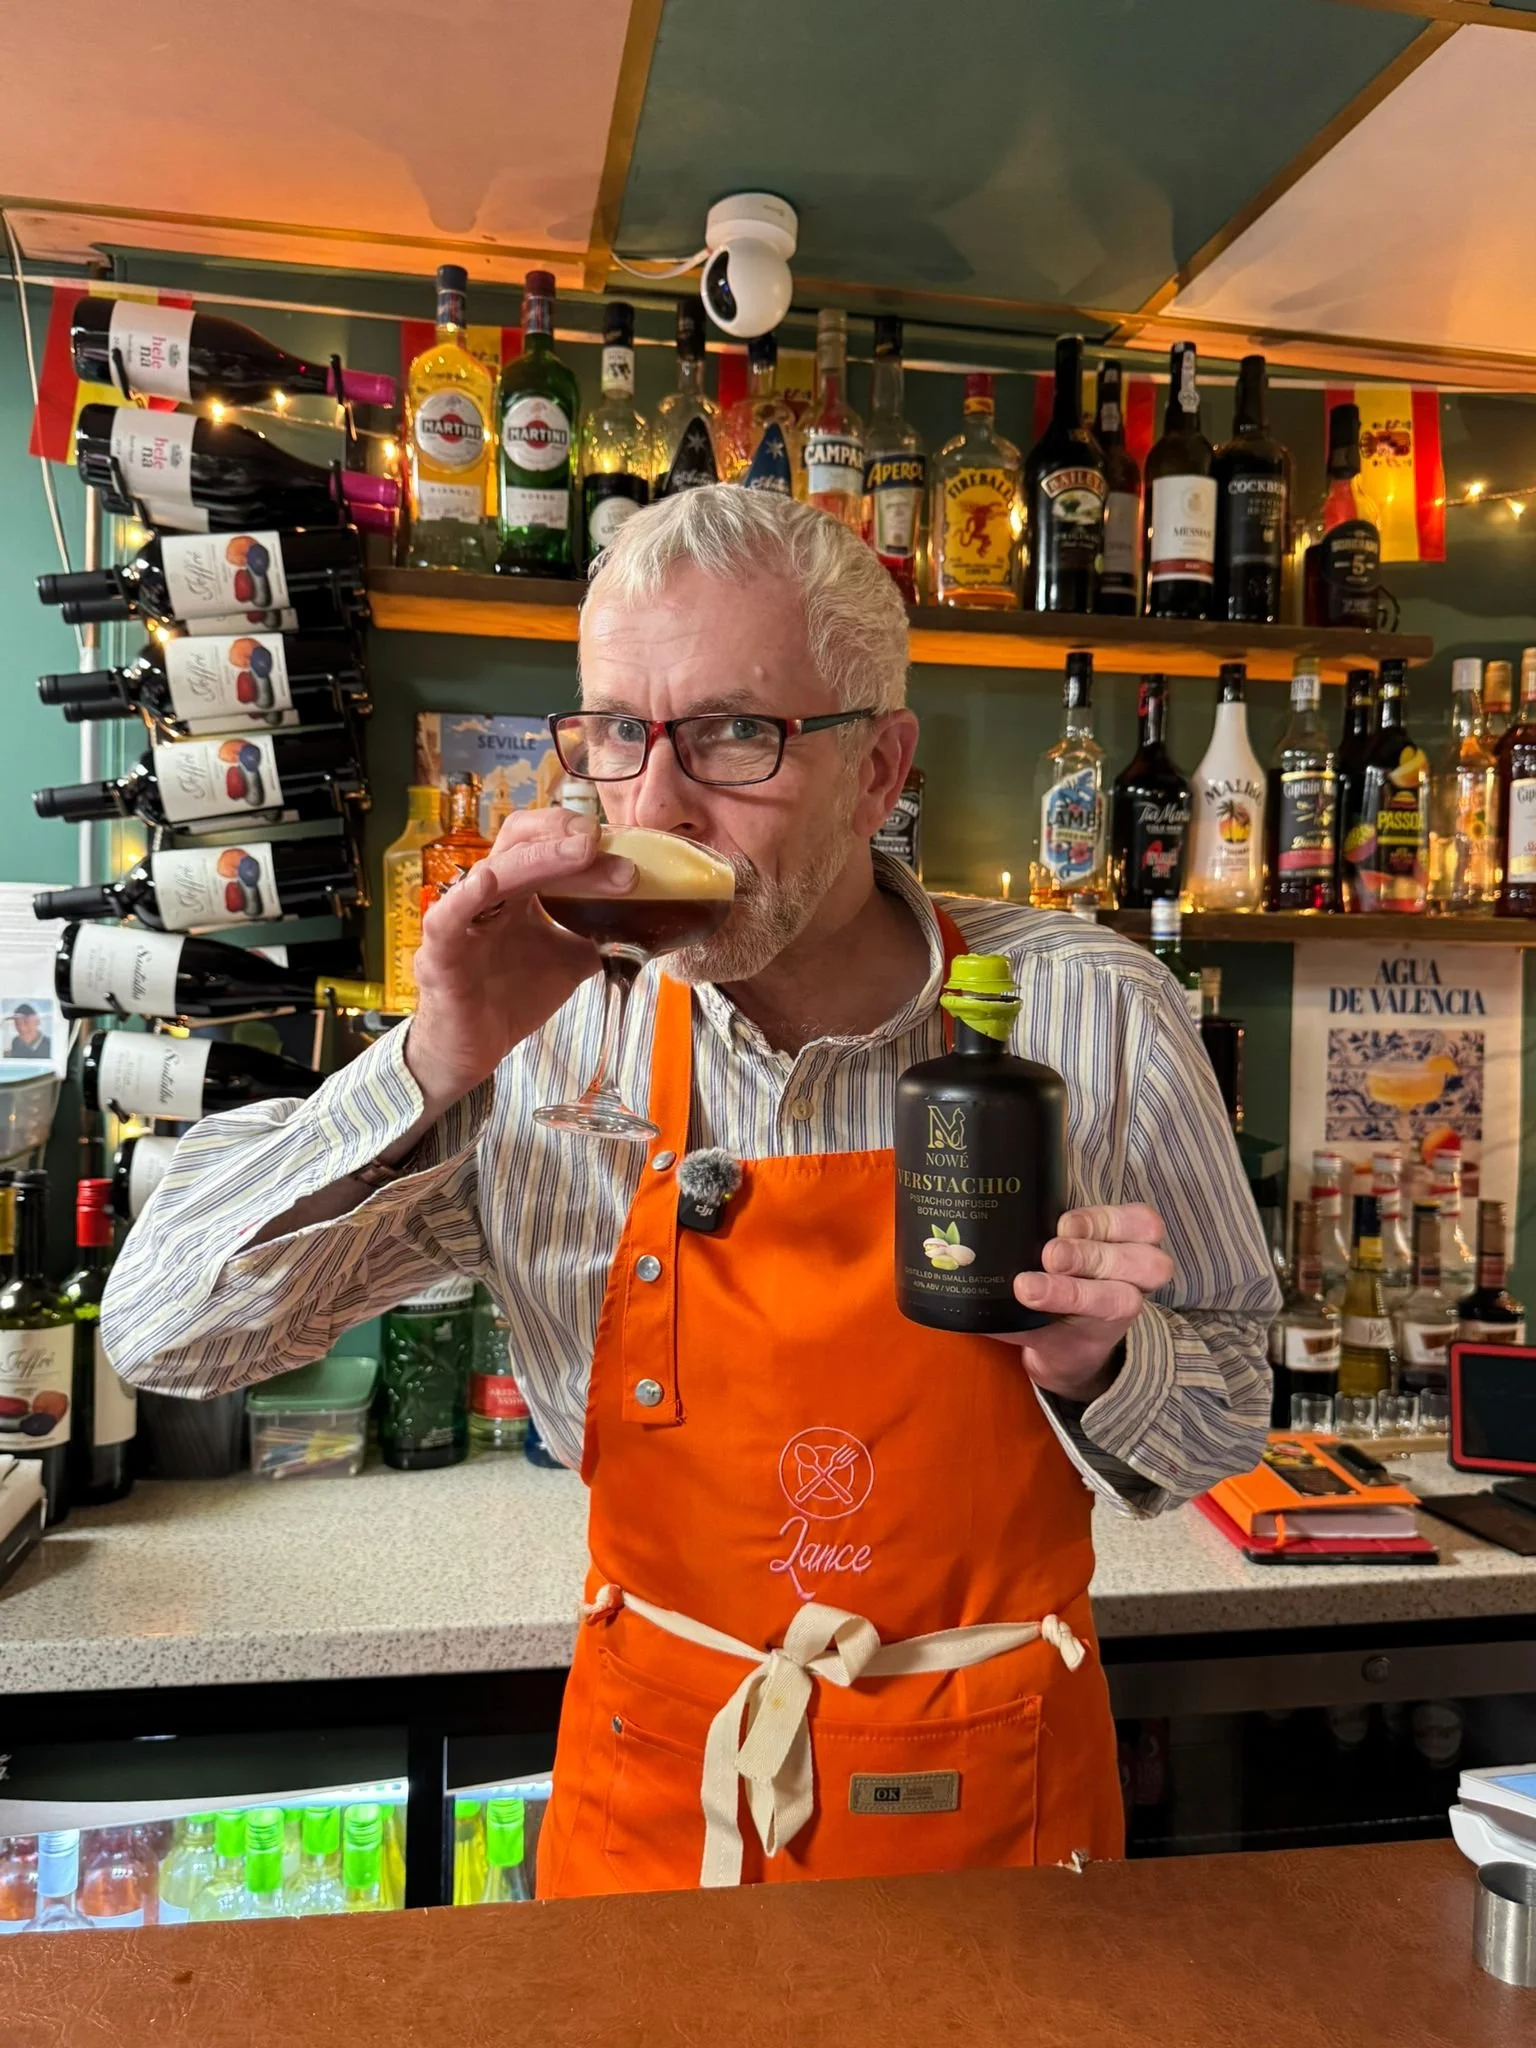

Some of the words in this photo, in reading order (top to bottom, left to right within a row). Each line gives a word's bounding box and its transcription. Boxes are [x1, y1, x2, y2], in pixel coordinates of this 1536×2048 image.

[139, 345, 152, 367] na
[151, 336, 167, 369] hele
[423, 420, 481, 440] MARTINI
[508, 427, 567, 443] MARTINI
[141, 446, 153, 468] na
[153, 436, 169, 470] hele
[867, 462, 924, 489] APEROL
[948, 470, 1014, 500] FIREBALL
[1352, 554, 1366, 576] 5
[478, 735, 537, 750] SEVILLE
[1204, 779, 1262, 806] MALIBU
[1377, 810, 1425, 830] PASSOA
[1376, 958, 1442, 986] AGUA
[1329, 987, 1364, 1014] DE
[1369, 987, 1487, 1015] VALENCIA
[926, 1151, 969, 1169] NOWÉ
[897, 1167, 1021, 1194] VERSTACHIO
[694, 1204, 714, 1217] dji
[910, 1193, 953, 1207] PISTACHIO
[954, 1199, 999, 1209] INFUSED
[917, 1206, 968, 1219] BOTANICAL
[970, 1211, 988, 1219] GIN
[925, 1282, 939, 1291] ABV
[946, 1285, 961, 1294] VOL
[942, 1274, 968, 1284] SMALL
[969, 1276, 1006, 1284] BATCHES
[769, 1516, 873, 1600] Lance
[876, 1788, 899, 1800] OK
